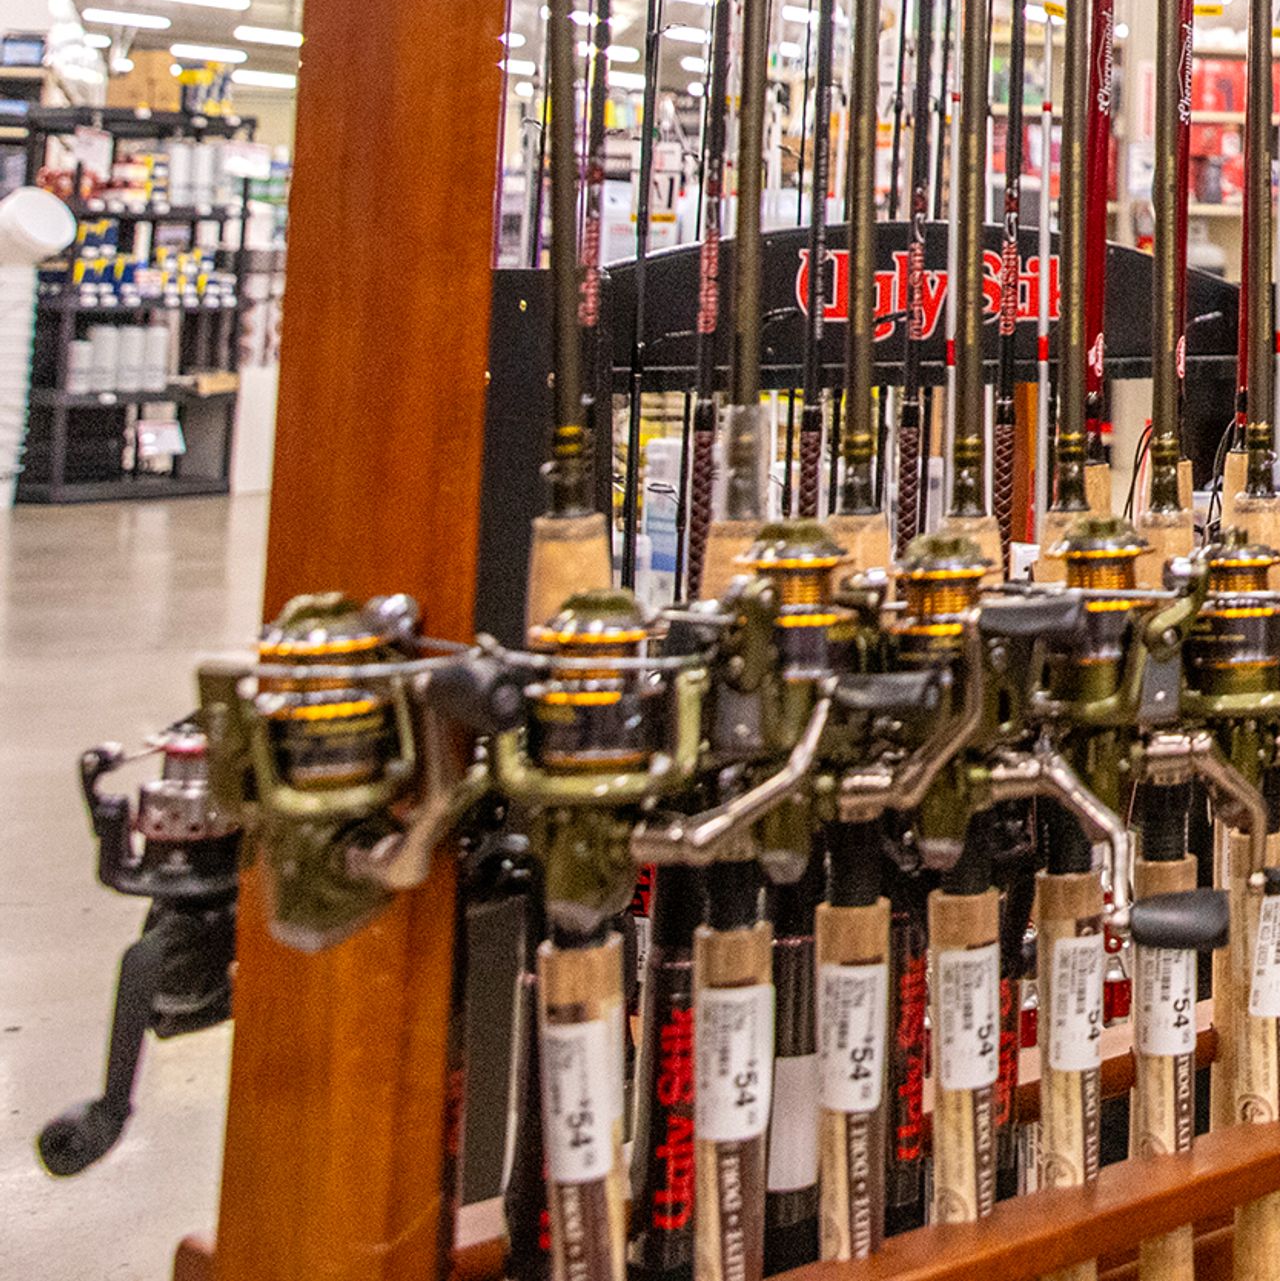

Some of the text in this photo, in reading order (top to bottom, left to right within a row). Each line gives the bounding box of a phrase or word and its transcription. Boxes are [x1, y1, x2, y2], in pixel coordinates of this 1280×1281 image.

[1095, 7, 1114, 116] Cherrywood
[1177, 19, 1194, 126] Cherrywood
[796, 249, 1062, 343] Ugly Sti
[653, 1007, 695, 1231] Ugly Stik
